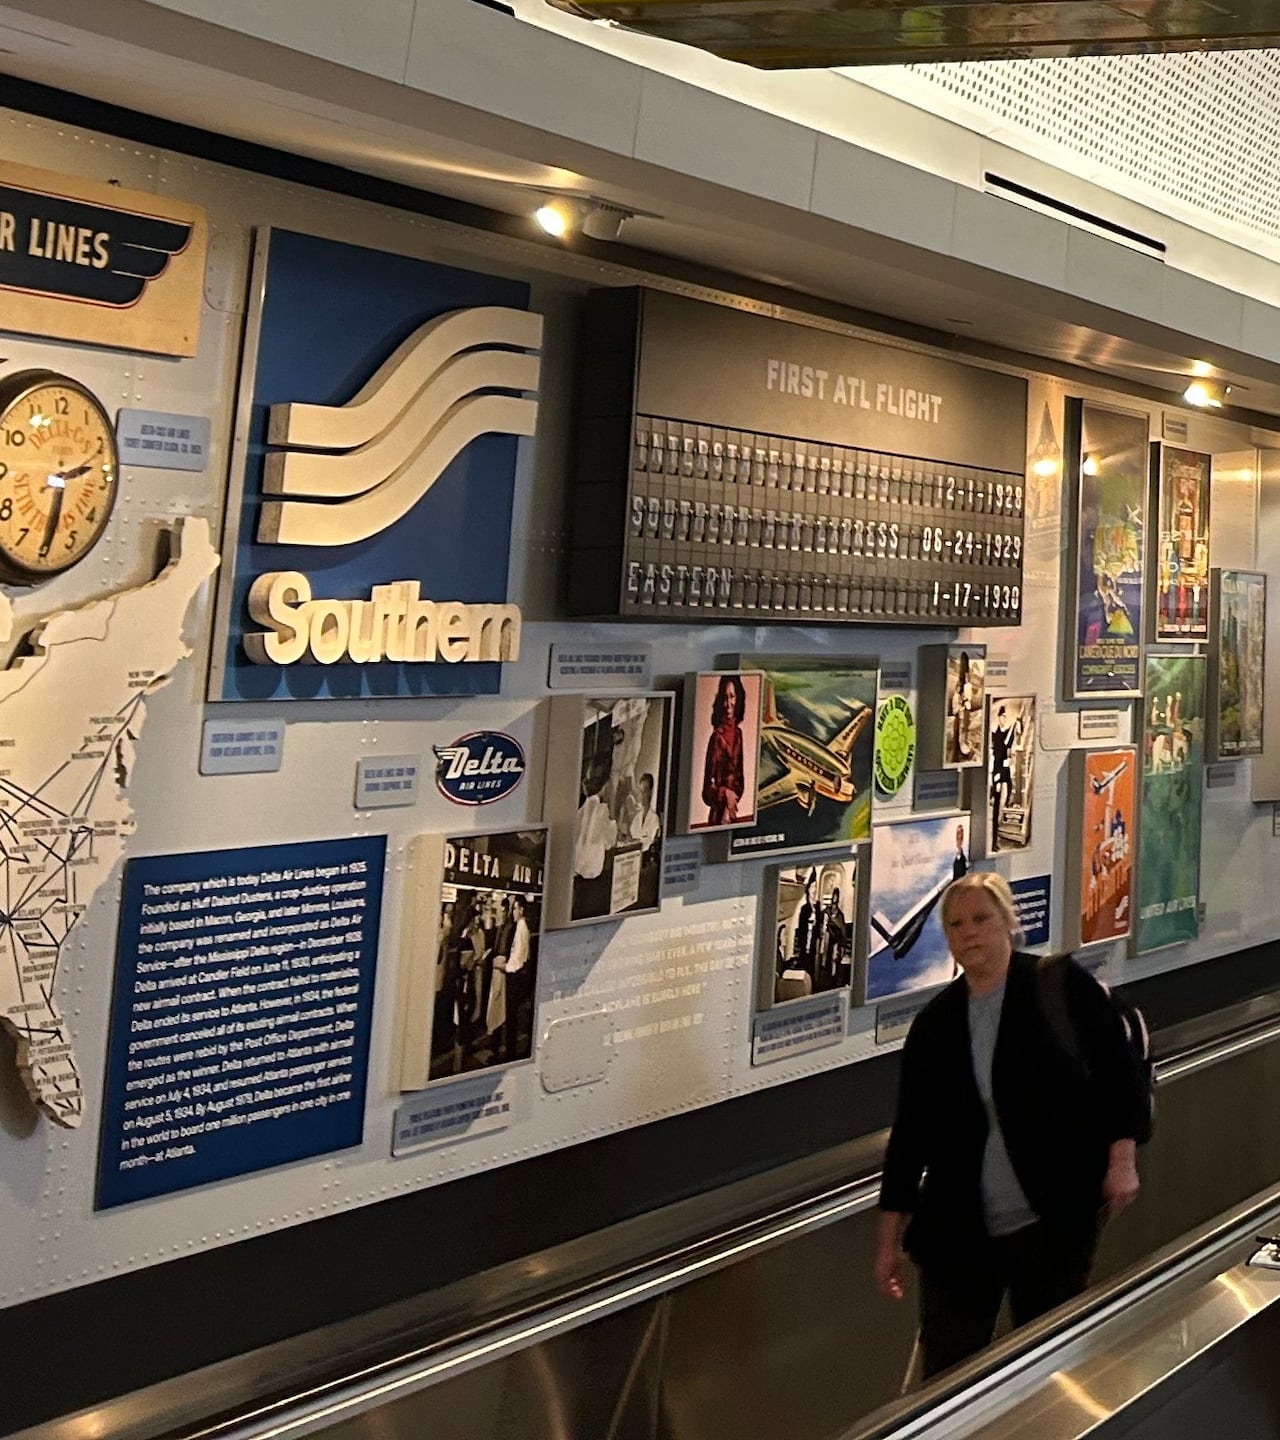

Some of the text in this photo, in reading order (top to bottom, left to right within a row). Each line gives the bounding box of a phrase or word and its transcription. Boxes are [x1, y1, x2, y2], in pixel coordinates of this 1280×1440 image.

[28, 218, 110, 269] LINES
[55, 397, 69, 416] 12
[767, 360, 942, 423] FIRST ATL FLIGHT
[6, 431, 25, 447] 10
[0, 499, 13, 521] 8
[937, 475, 1022, 510] 12-1-1928
[15, 528, 29, 547] 7
[65, 531, 77, 550] 5
[632, 495, 749, 539] SOUTHERN
[817, 515, 898, 550] EXPRESS
[922, 526, 1021, 560] 06-24-1929
[627, 562, 1019, 610] EASTERN 1-17-1930
[250, 571, 521, 664] Southern
[440, 747, 524, 779] Delta
[458, 779, 502, 791] AIR LINES
[143, 882, 161, 896] The
[161, 880, 201, 896] company
[201, 875, 228, 890] which
[226, 874, 236, 887] is
[235, 872, 260, 888] today
[259, 869, 282, 883] Delta
[281, 868, 294, 881] Air
[292, 866, 315, 879] Lines
[313, 863, 340, 879] began
[339, 862, 348, 874] in
[444, 843, 544, 885] DELTA AIR L
[140, 899, 180, 915] Founded
[179, 900, 191, 911] as
[191, 896, 211, 909] Huff
[209, 892, 241, 907] Daland
[239, 888, 273, 906] Dusters,
[279, 882, 331, 901] crop-dusting
[329, 878, 366, 895] operation
[137, 913, 362, 955] the company was renamed and incorporated as Delta Air
[167, 916, 196, 931] based
[194, 915, 204, 928] in
[202, 911, 234, 929] Macon,
[233, 907, 267, 925] Georgia,
[267, 905, 284, 918] and
[282, 903, 301, 917] later
[133, 978, 157, 994] Delta
[157, 973, 188, 990] arrived
[186, 972, 198, 985] at
[196, 967, 230, 984] Candler
[229, 964, 251, 979] Field
[249, 965, 262, 976] on
[262, 960, 281, 974] June
[280, 958, 290, 973] 11,
[289, 955, 311, 972] 1930,
[310, 948, 355, 968] anticipating
[136, 954, 192, 974] Service—after
[192, 952, 208, 966] the
[248, 943, 270, 957] Delta
[268, 938, 307, 957] region—in
[306, 933, 344, 949] December
